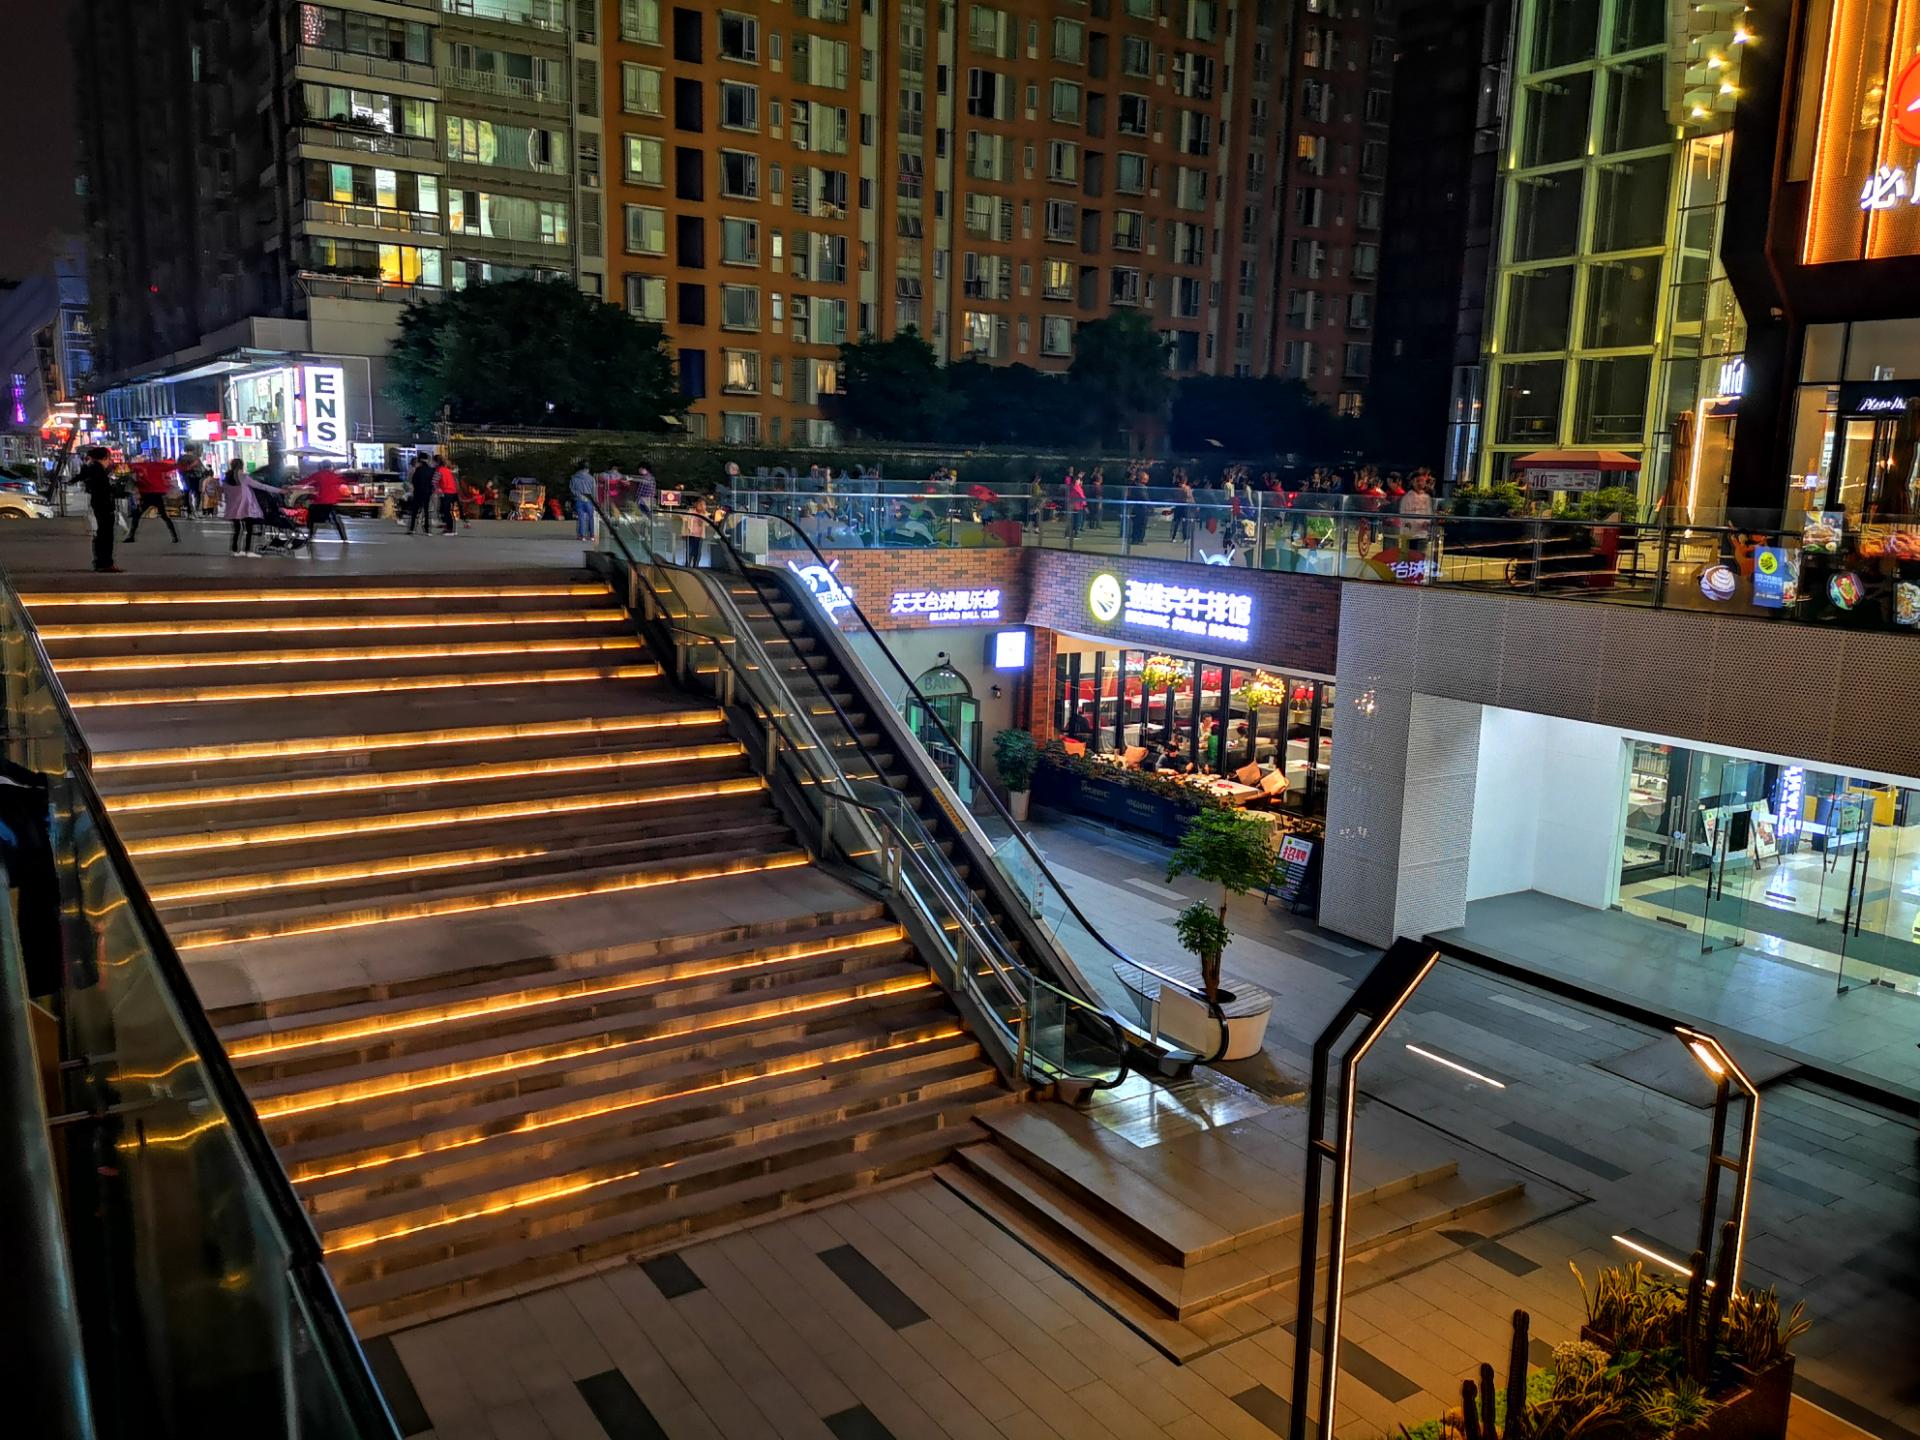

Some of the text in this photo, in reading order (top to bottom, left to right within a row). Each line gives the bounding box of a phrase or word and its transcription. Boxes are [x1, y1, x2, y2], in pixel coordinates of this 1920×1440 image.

[1860, 161, 1920, 210] 必
[891, 589, 1000, 613] 天天台球俱乐部
